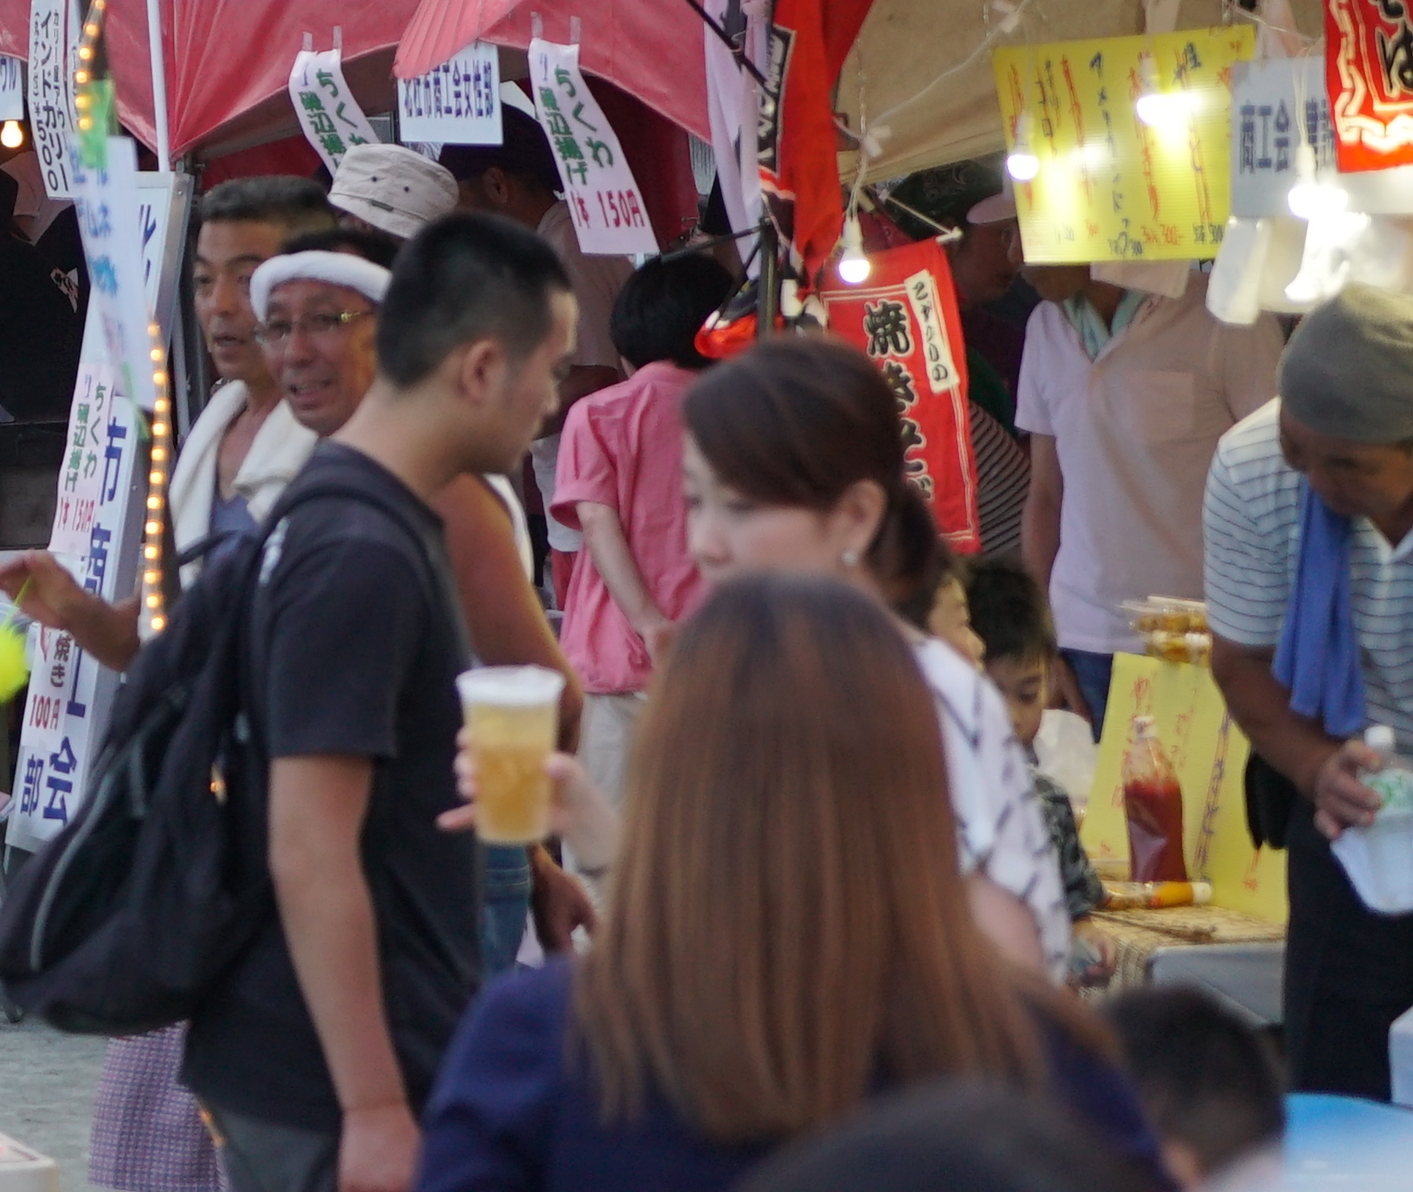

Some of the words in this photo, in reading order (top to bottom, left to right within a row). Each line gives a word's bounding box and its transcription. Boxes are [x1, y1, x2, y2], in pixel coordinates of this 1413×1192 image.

[41, 10, 69, 192] インドカリー
[555, 64, 615, 168] ちくわ
[597, 189, 646, 229] 150円
[84, 381, 107, 480] ちくわ
[29, 693, 61, 730] 100円
[20, 753, 45, 818] 部
